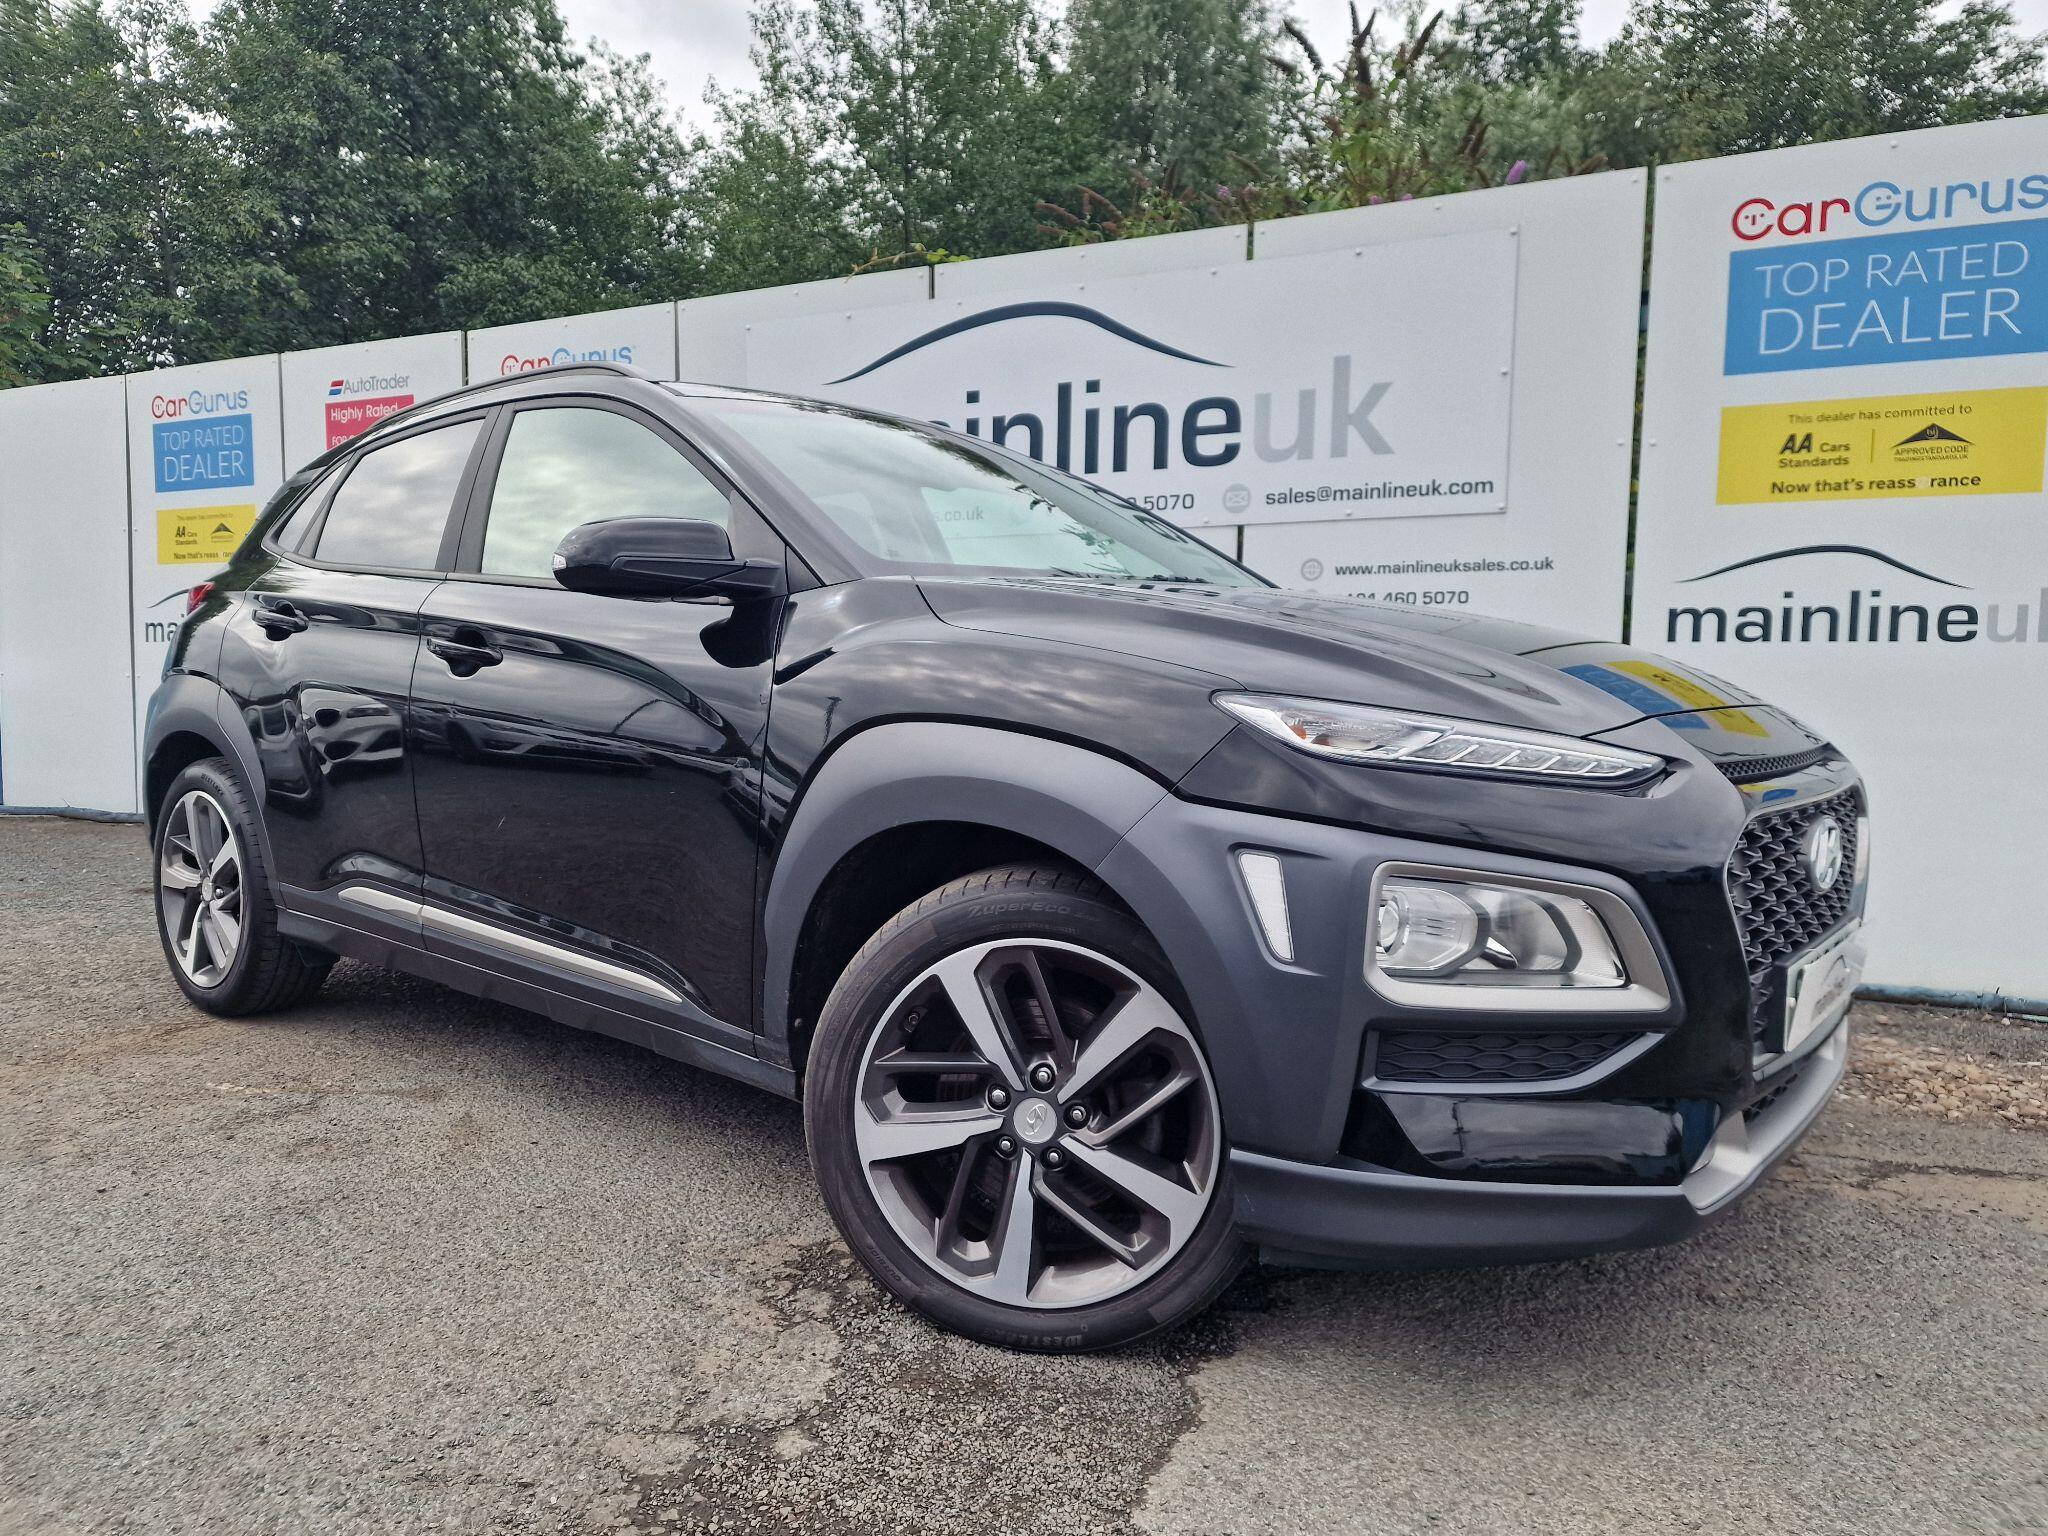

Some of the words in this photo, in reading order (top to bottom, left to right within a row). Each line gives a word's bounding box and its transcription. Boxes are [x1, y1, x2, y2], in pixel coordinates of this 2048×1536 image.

[1732, 174, 2048, 241] CarGurus
[1754, 258, 1850, 298] TOP
[1867, 240, 2030, 289] RATED
[1758, 287, 2022, 356] DEALER
[343, 373, 409, 395] AutoTrader
[151, 390, 249, 419] CarGurus
[330, 406, 363, 423] Highly
[1789, 413, 1813, 424] This
[1816, 412, 1855, 422] dealer
[1859, 411, 1881, 420] has
[1885, 405, 1955, 418] committed
[1959, 404, 1972, 415] to
[161, 430, 191, 451] TOP
[194, 425, 245, 448] RATED
[1779, 432, 1813, 455] AA
[1820, 441, 1850, 453] Cars
[1894, 446, 1943, 456] APPROVED
[1945, 444, 1969, 453] CODE
[164, 450, 245, 482] DEALER
[1779, 457, 1850, 469] Standards
[1266, 478, 1494, 505] sales@mainlineuk.com
[1771, 480, 1811, 494] Now
[1815, 478, 1864, 493] that's
[175, 526, 186, 538] AA
[1335, 556, 1554, 576] www.mainlineuksales.co.uk
[1422, 590, 1469, 605] 5070
